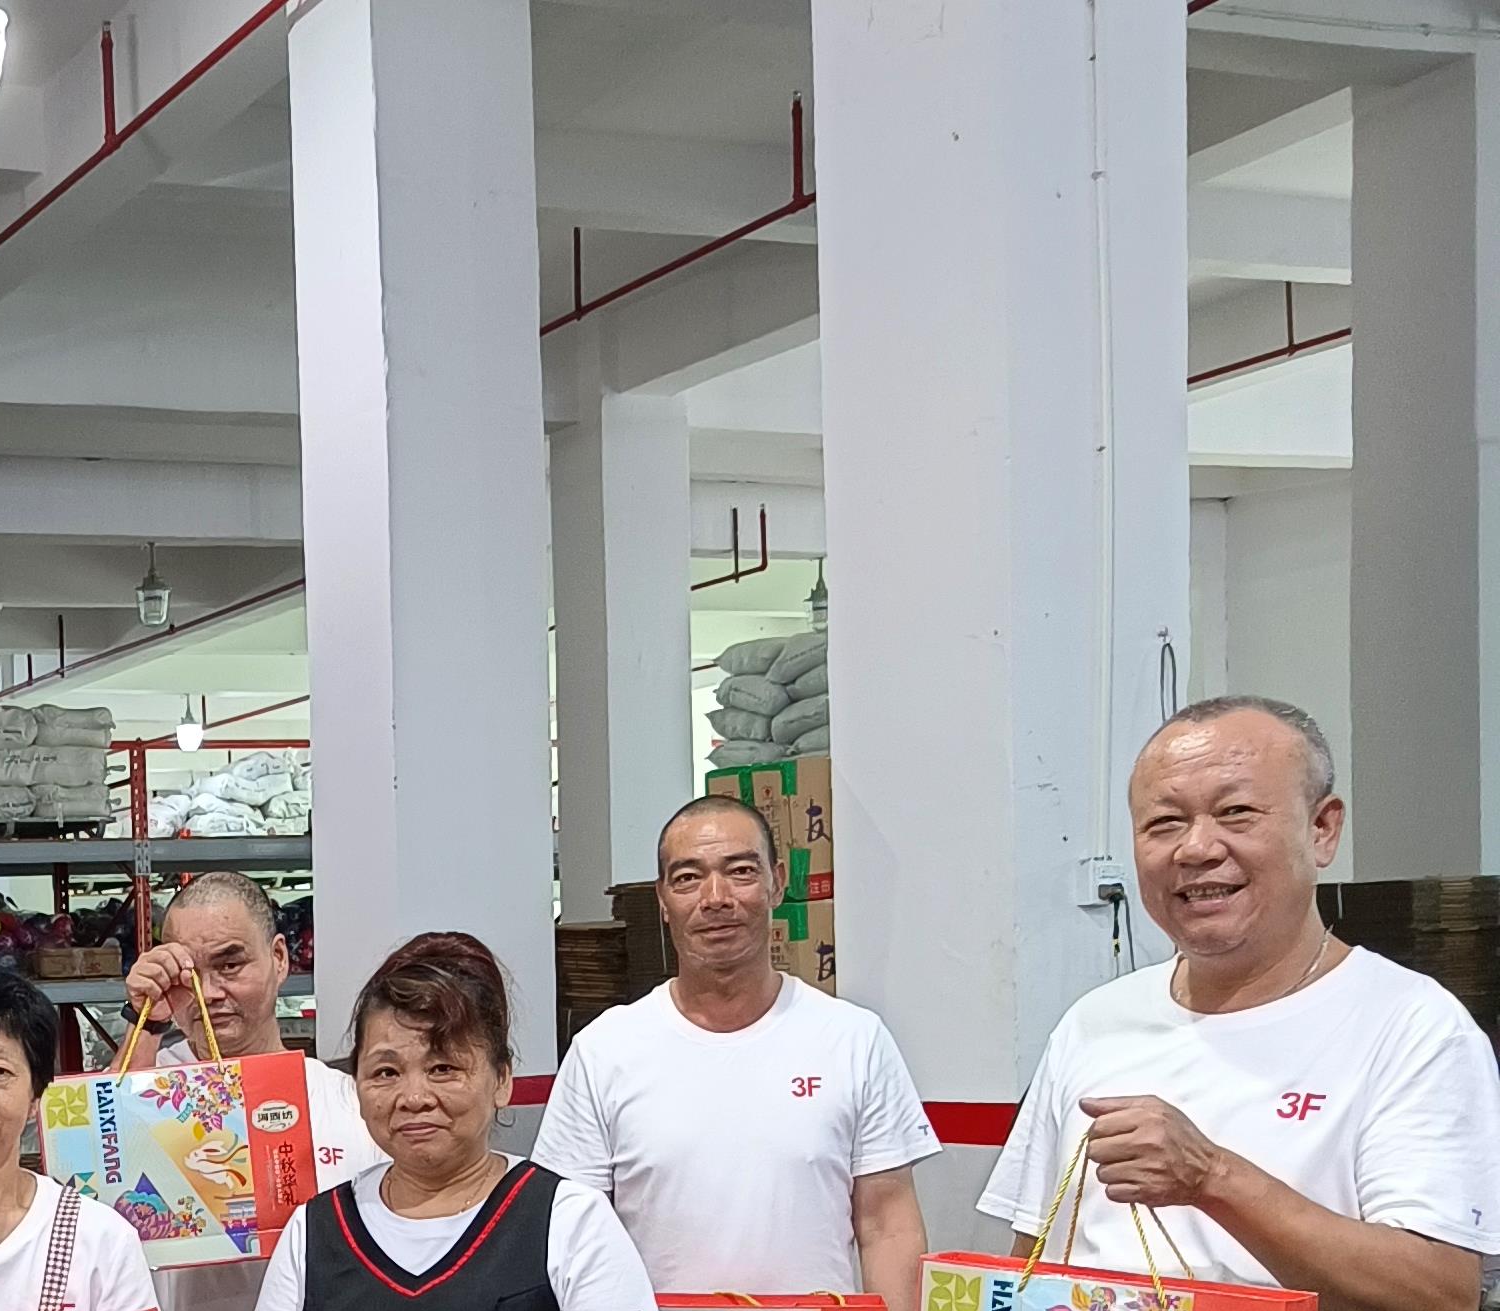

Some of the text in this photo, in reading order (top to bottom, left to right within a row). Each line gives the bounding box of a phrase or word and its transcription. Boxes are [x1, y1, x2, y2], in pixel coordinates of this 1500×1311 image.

[791, 1076, 822, 1097] 3F
[1276, 1092, 1327, 1121] 3F
[318, 1146, 344, 1166] 3F
